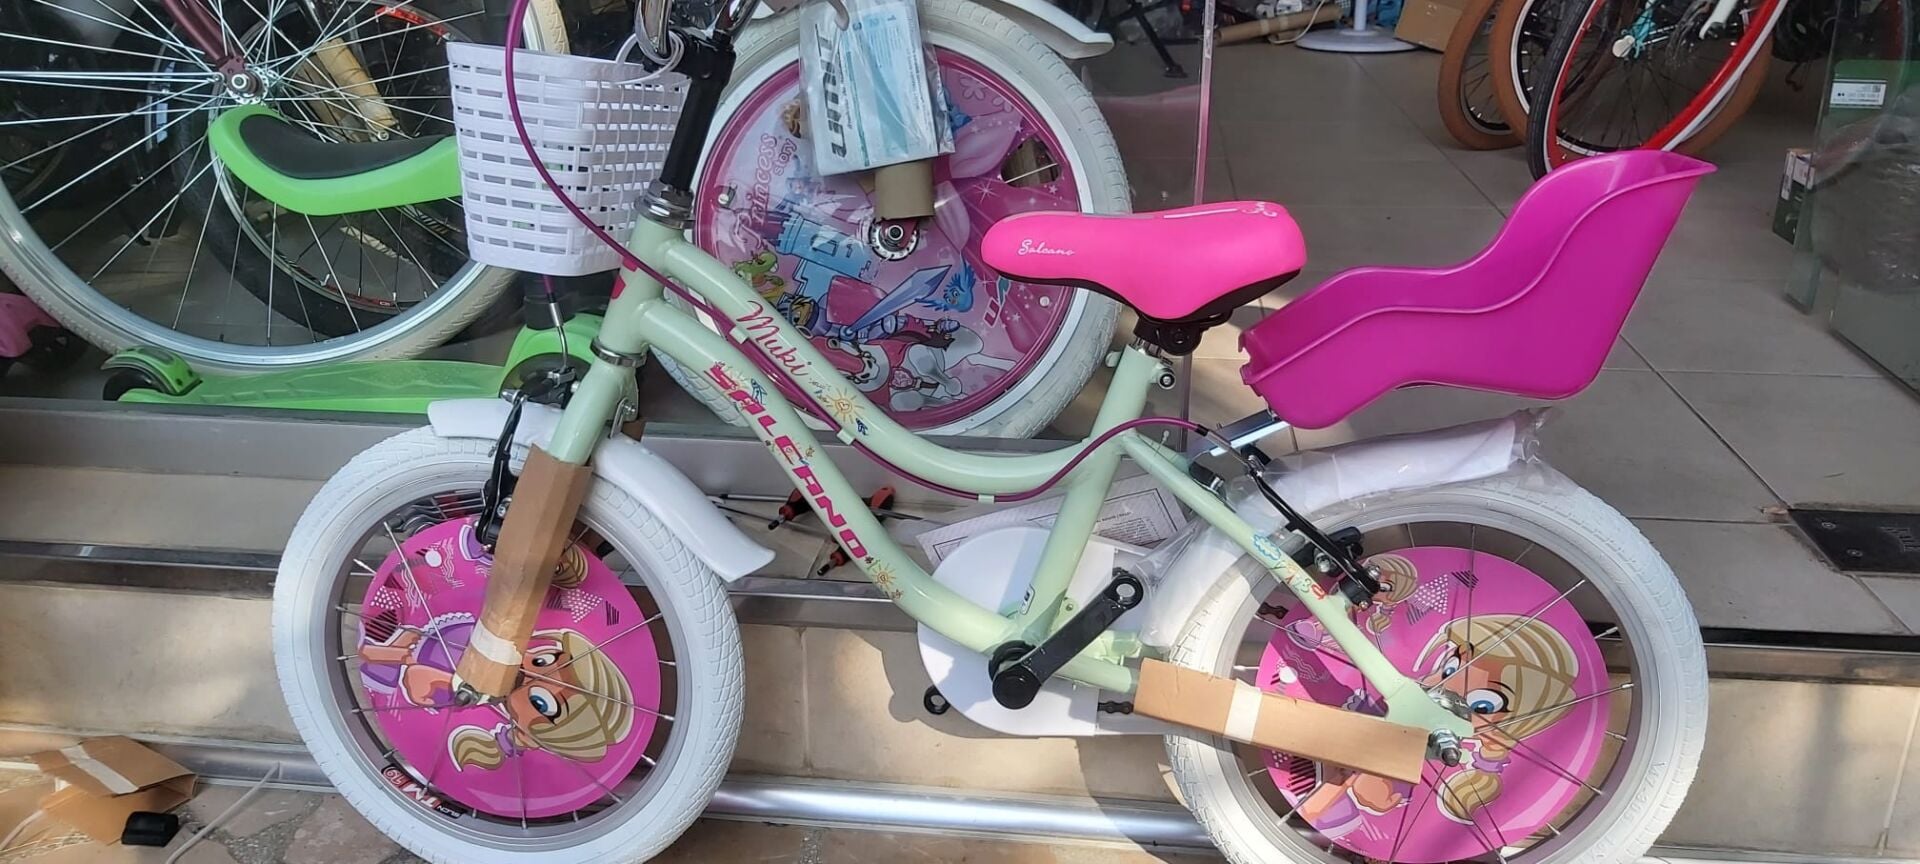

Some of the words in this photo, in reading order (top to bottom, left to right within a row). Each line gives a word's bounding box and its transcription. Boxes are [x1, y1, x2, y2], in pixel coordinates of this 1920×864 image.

[732, 133, 777, 253] Princess
[773, 138, 797, 176] story
[1017, 238, 1076, 256] Salcano
[735, 300, 812, 376] Muki
[704, 361, 867, 559] SALCANO
